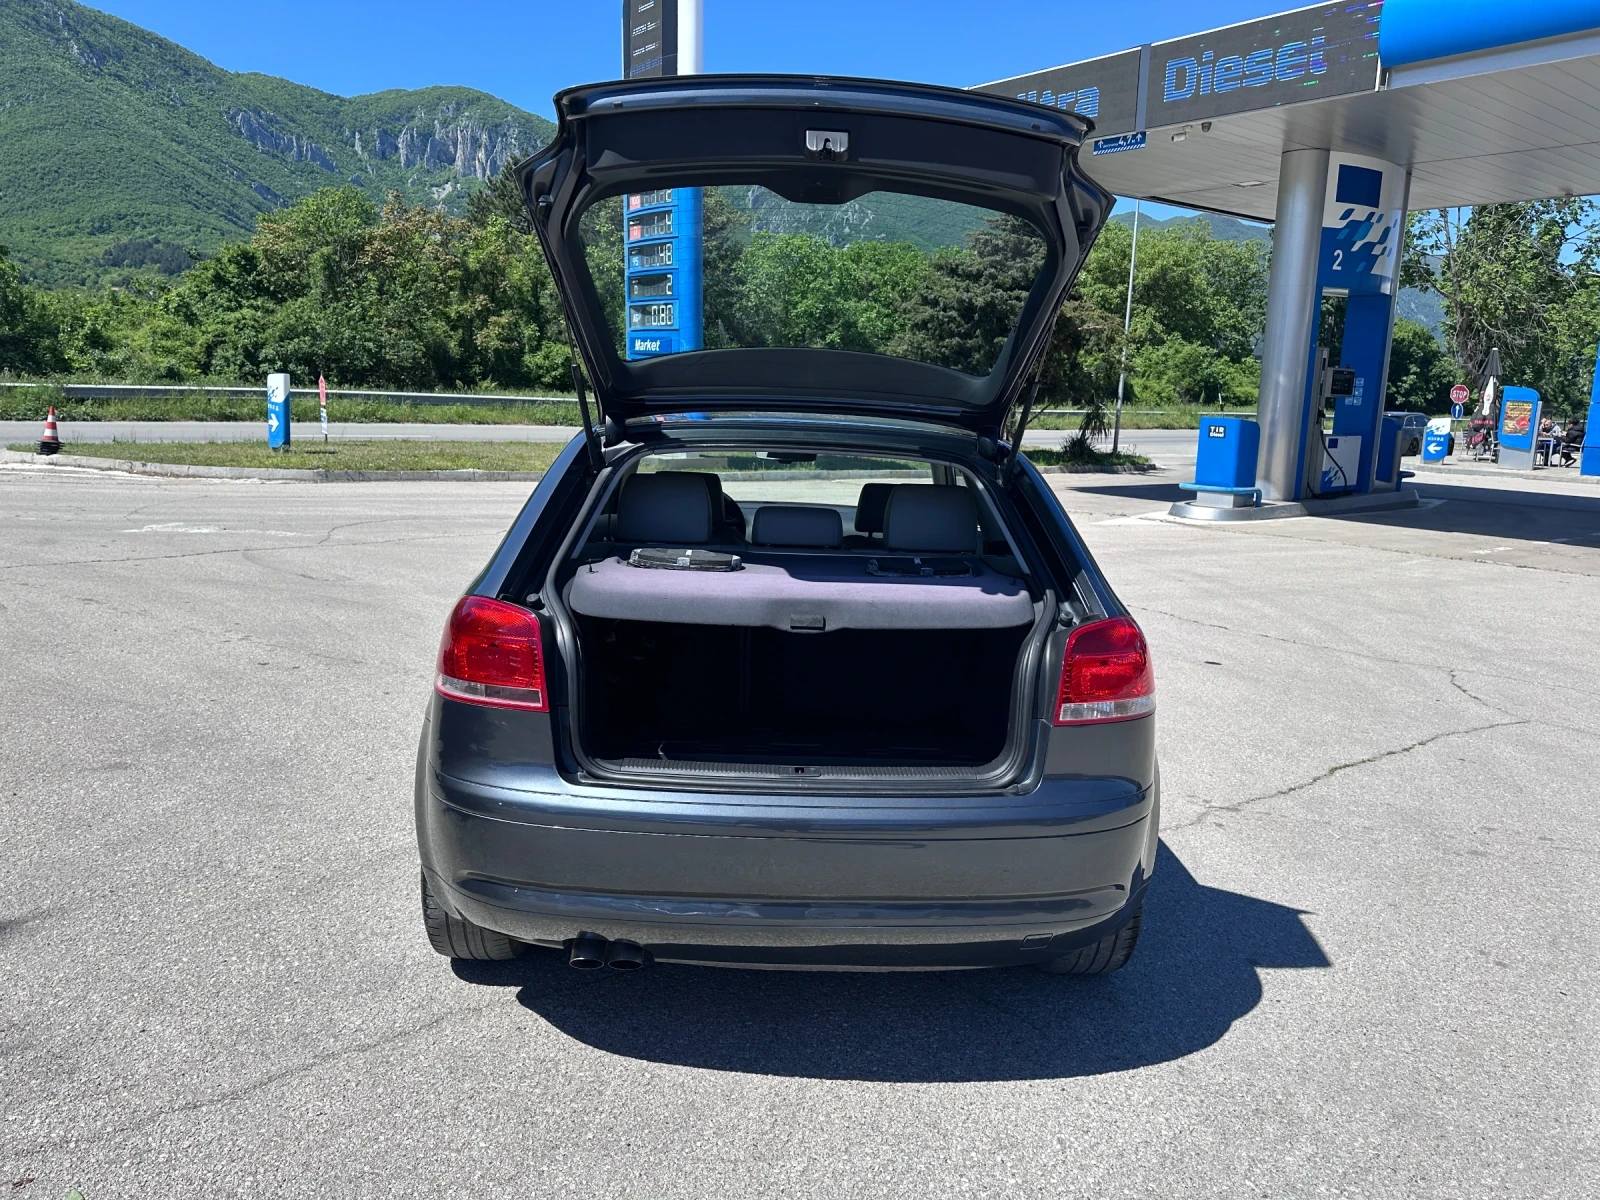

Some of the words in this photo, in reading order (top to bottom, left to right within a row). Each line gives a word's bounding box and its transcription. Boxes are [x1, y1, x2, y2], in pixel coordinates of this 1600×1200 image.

[1164, 30, 1327, 102] Diesel
[1332, 249, 1343, 270] 2
[634, 338, 661, 351] Market
[1452, 390, 1468, 399] STOP
